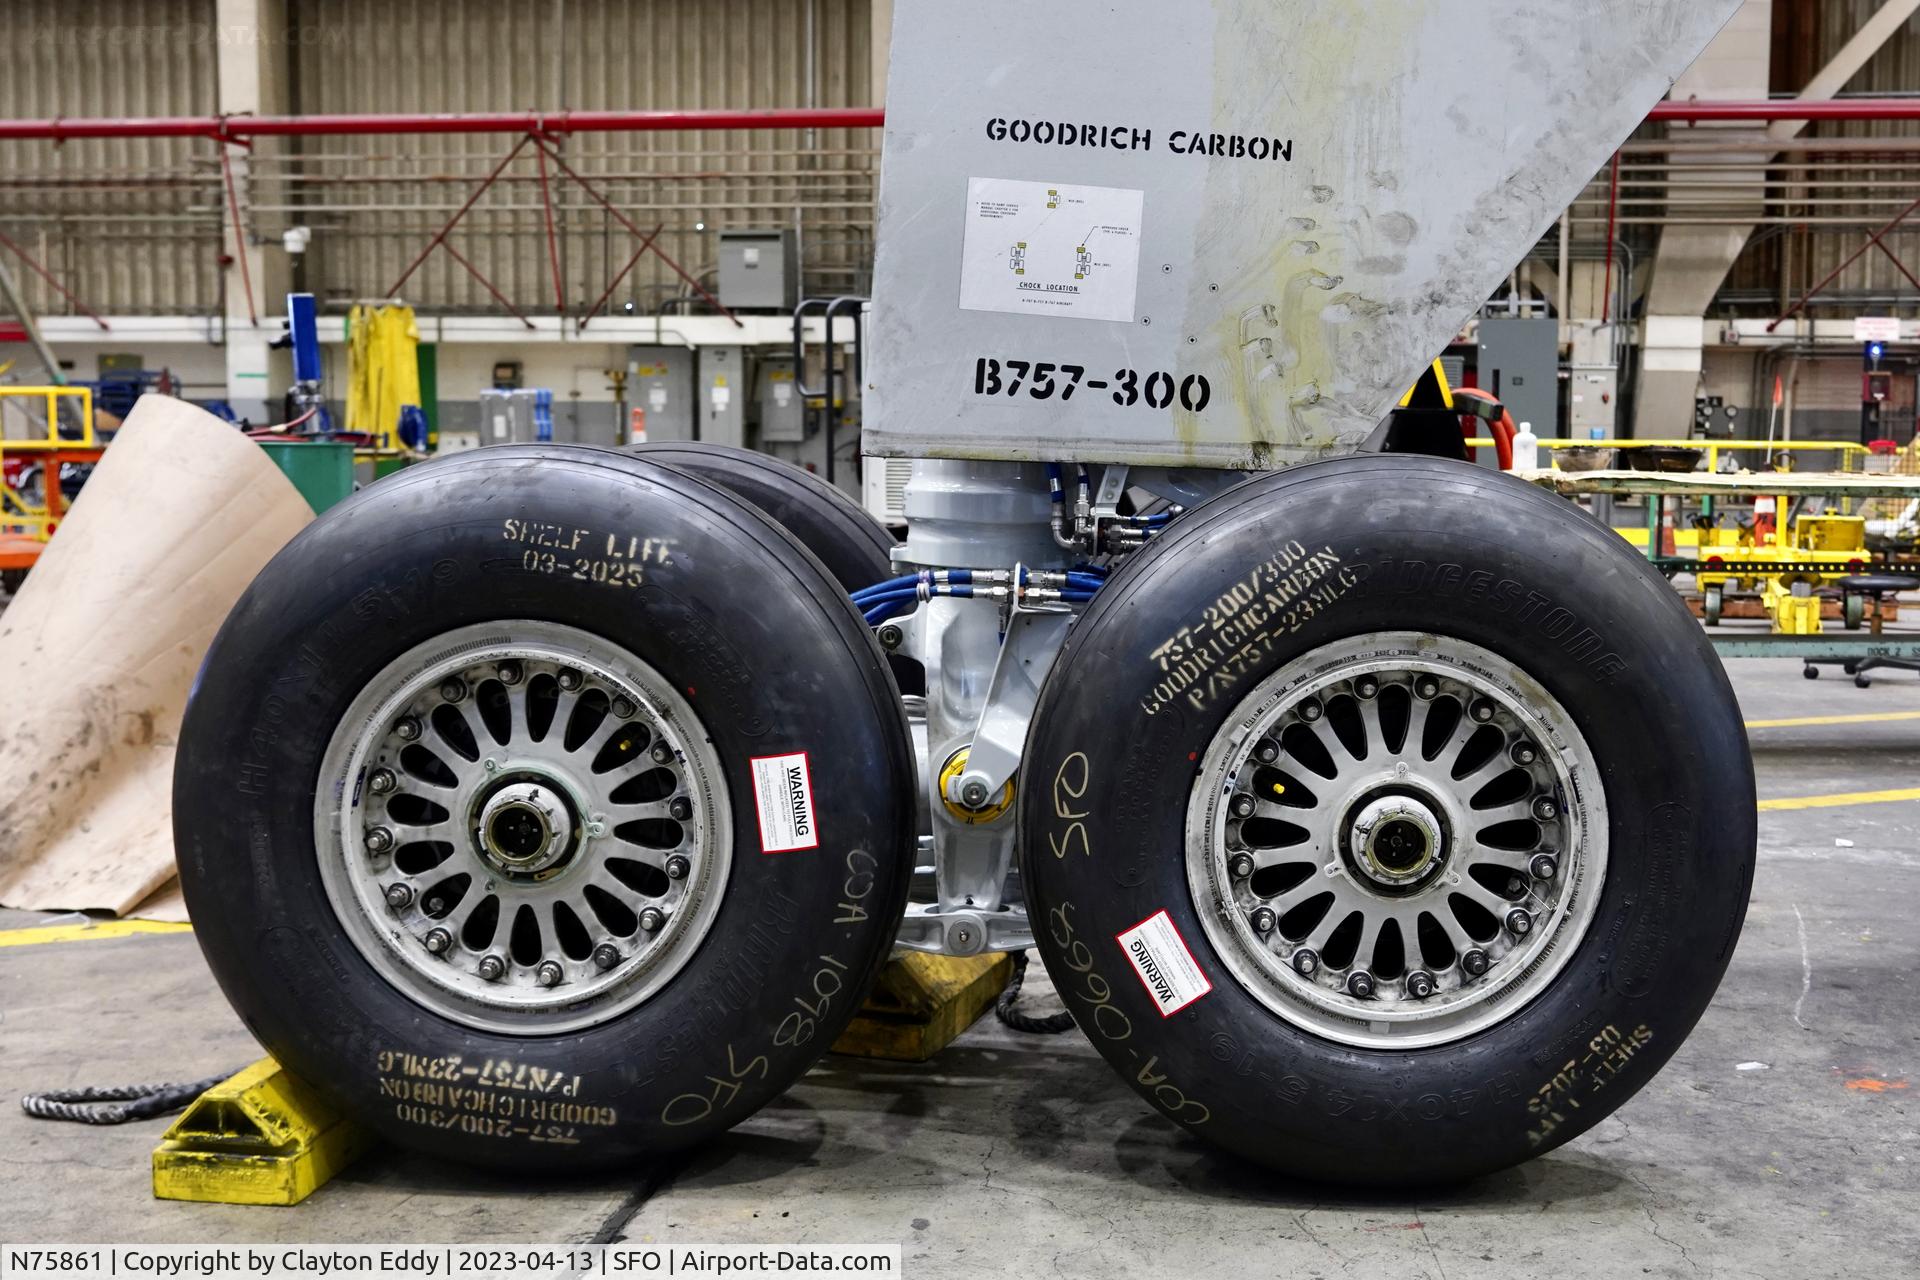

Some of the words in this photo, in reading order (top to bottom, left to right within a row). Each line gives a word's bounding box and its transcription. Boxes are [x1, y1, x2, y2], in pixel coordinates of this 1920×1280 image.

[986, 118, 1152, 151] GOODRICH
[1168, 131, 1293, 162] CARBON
[1019, 281, 1042, 289] CHOCK
[1046, 284, 1079, 292] LOCATION
[975, 358, 1211, 412] B757-300
[503, 518, 590, 550] SHELF
[607, 533, 679, 565] LIFE
[523, 549, 644, 587] 03-2025
[1150, 540, 1306, 671] 757-200/300
[1867, 647, 1890, 657] DOCK
[789, 766, 809, 836] WARNING
[1049, 751, 1090, 859] SFO
[1130, 940, 1172, 1004] WARNING
[661, 1044, 769, 1126] SFO
[1527, 1024, 1622, 1114] 03-2025
[1592, 1024, 1654, 1092] SHELF
[396, 1103, 582, 1144] 757-200/300
